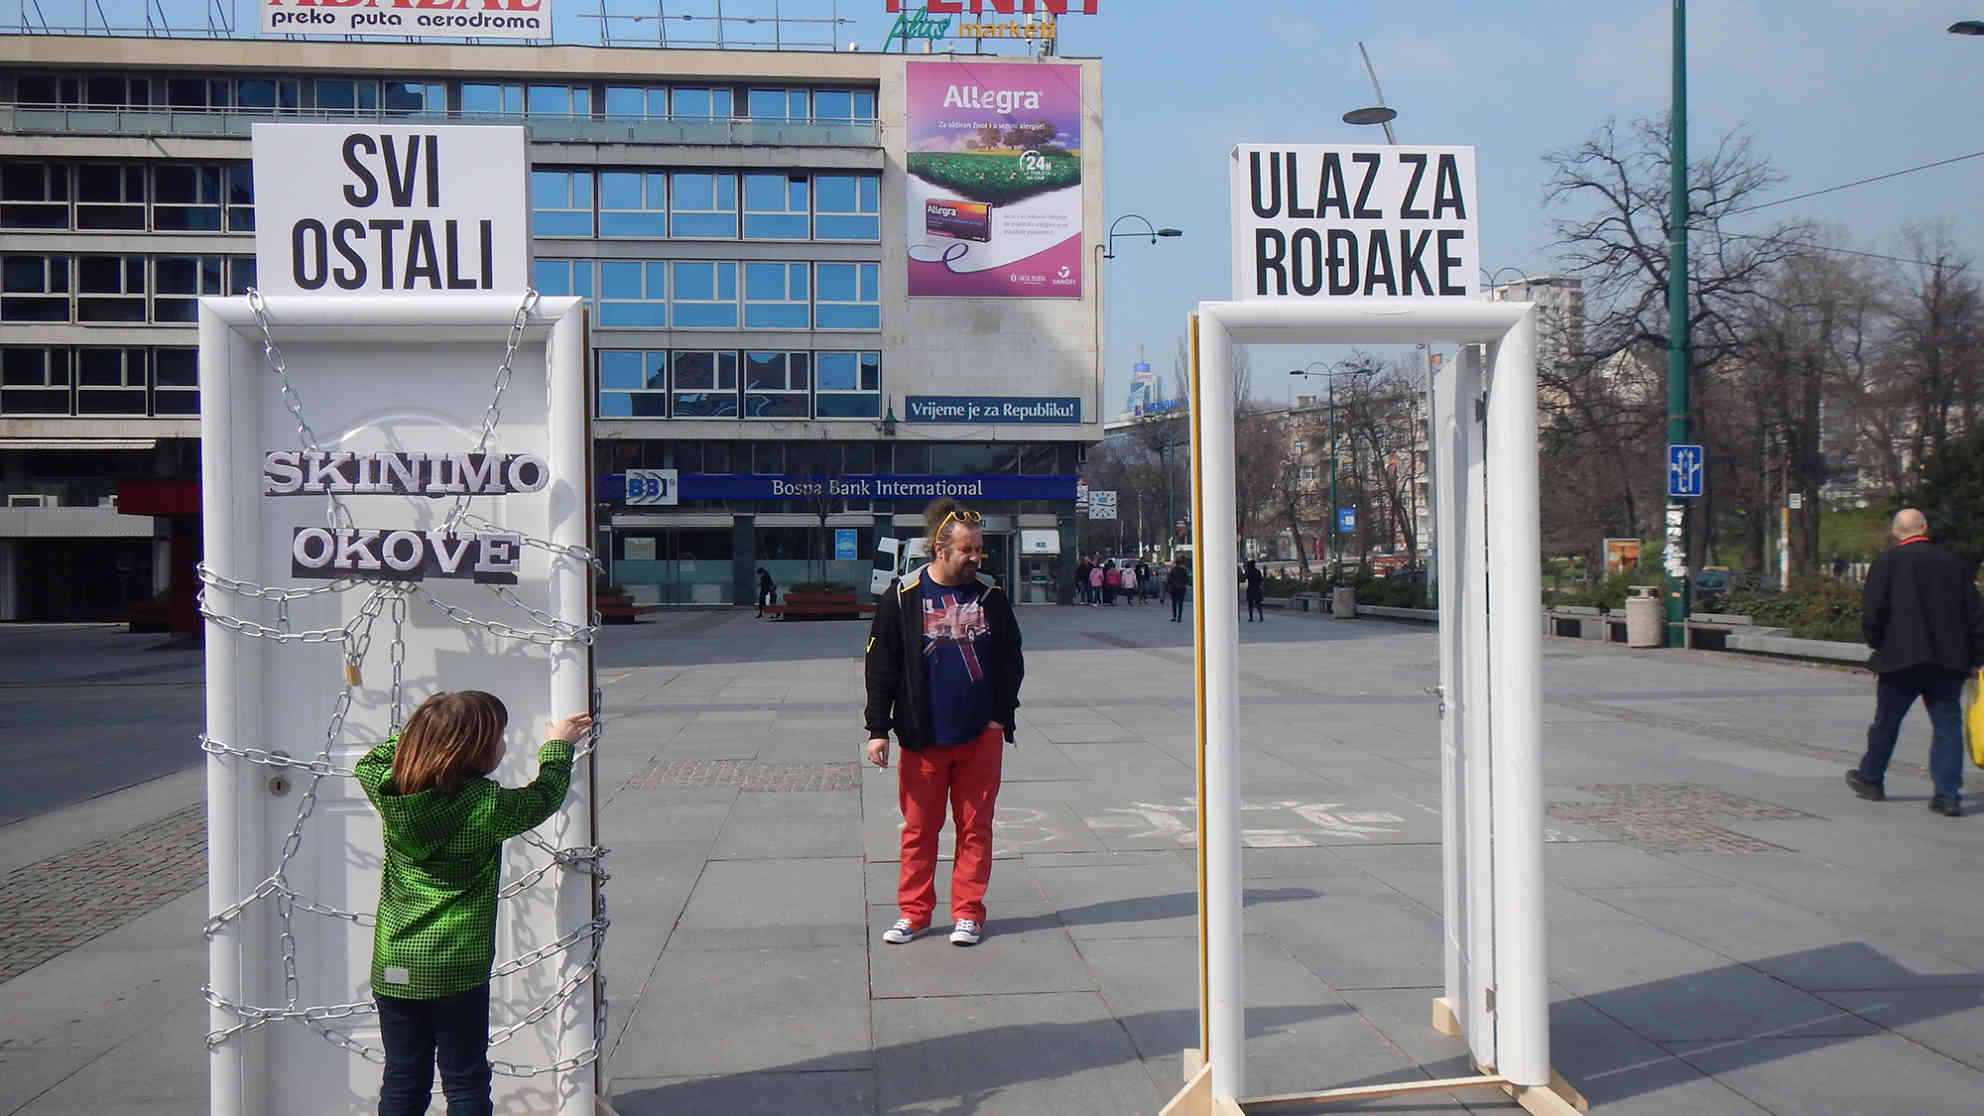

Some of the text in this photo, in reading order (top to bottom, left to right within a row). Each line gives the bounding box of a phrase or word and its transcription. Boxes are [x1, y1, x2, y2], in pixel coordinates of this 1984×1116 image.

[272, 8, 541, 29] preko puta aerodroma
[883, 6, 951, 52] plus
[943, 85, 1040, 114] Allegra
[342, 133, 440, 208] SVI
[1249, 151, 1467, 220] ULAZ ZA
[291, 218, 493, 290] OSTALI
[1255, 227, 1467, 297] ROĐAKE
[911, 402, 1075, 421] Vrijeme je za Republiku!
[263, 451, 551, 494] SKINIMO
[772, 479, 983, 496] Bosna Bank International
[292, 527, 521, 574] OKOVE
